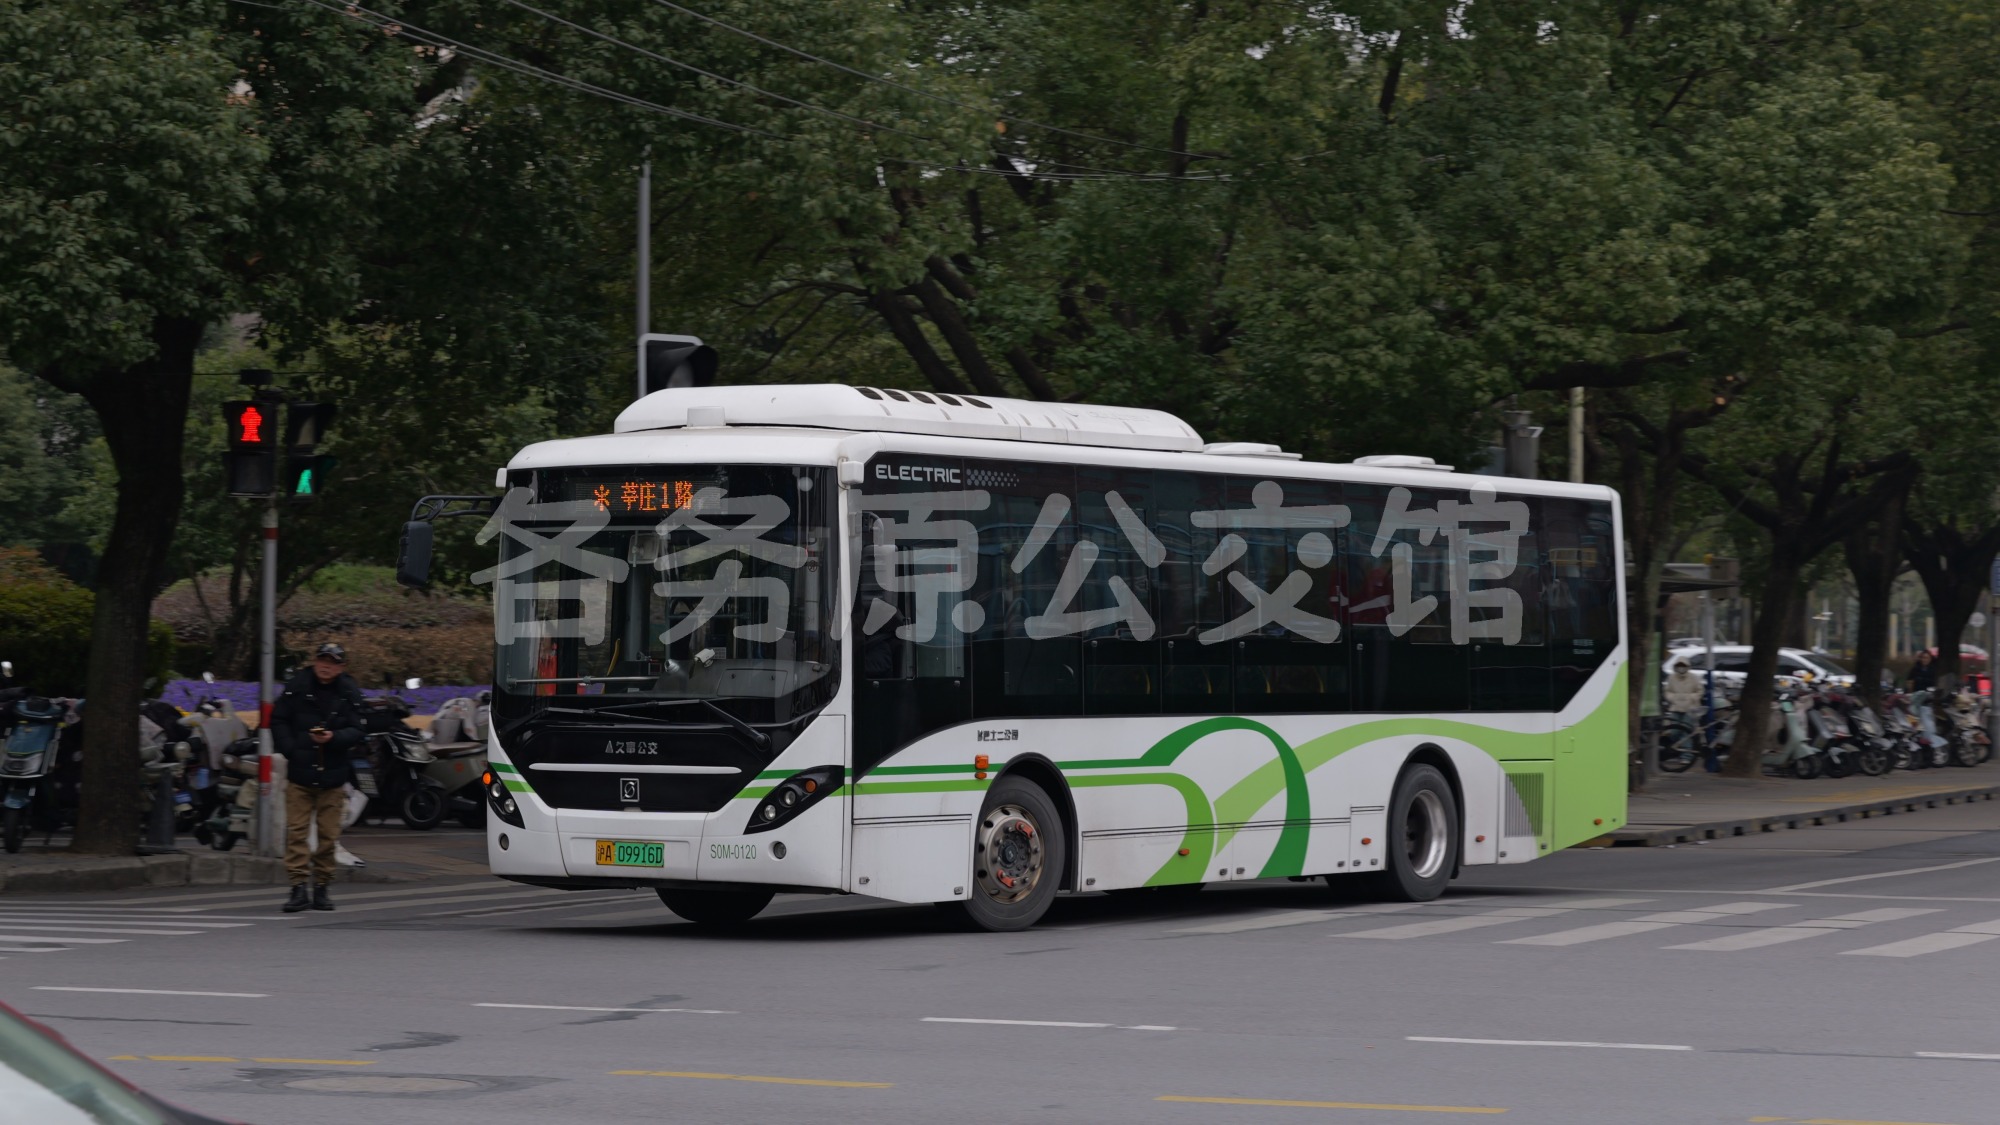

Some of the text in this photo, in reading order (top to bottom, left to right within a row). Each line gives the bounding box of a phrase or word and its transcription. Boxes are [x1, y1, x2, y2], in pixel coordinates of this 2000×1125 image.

[876, 464, 961, 483] ELECTRIC
[621, 481, 693, 511] 莘庄1路
